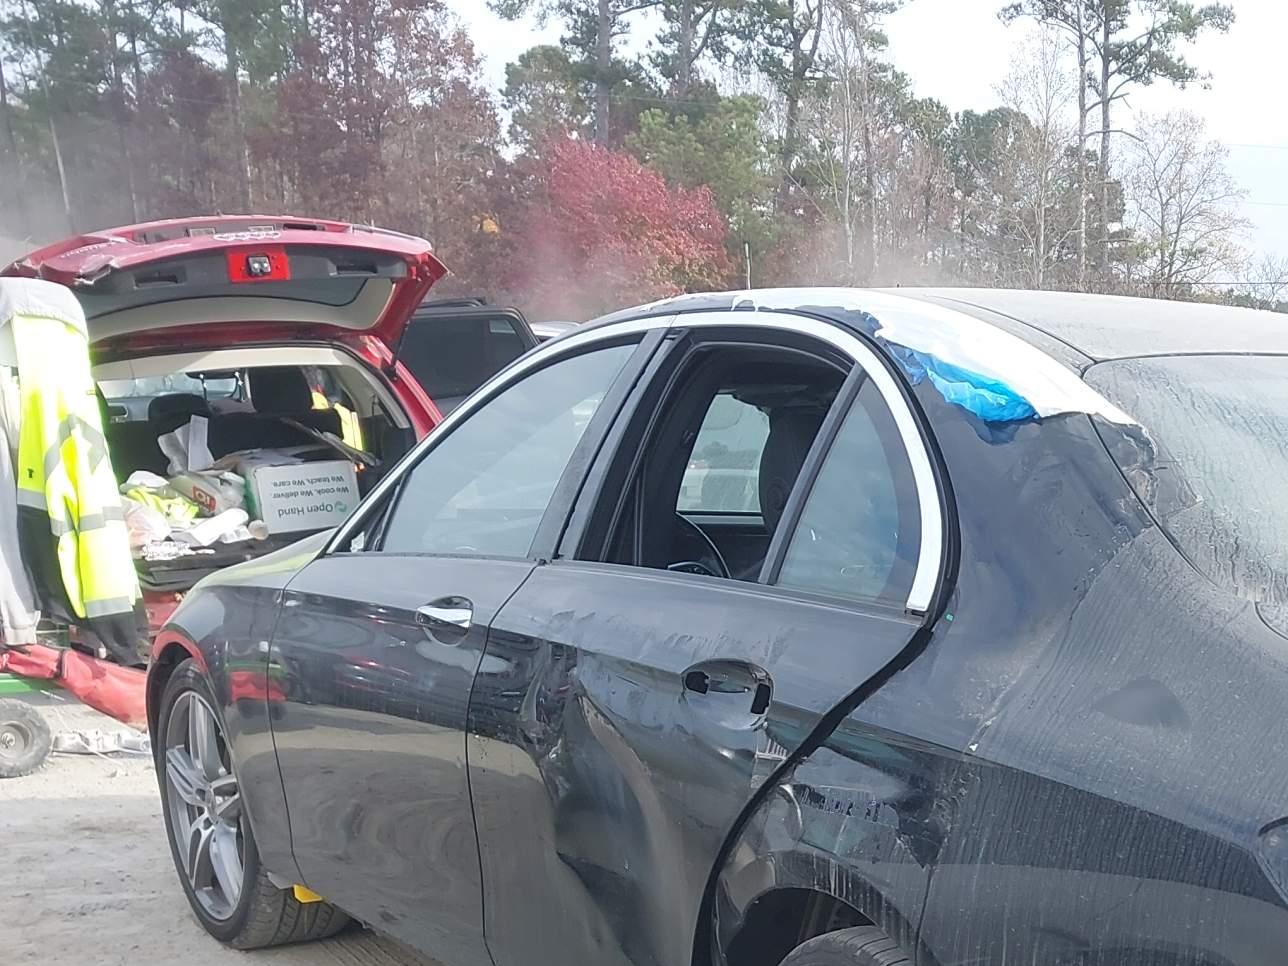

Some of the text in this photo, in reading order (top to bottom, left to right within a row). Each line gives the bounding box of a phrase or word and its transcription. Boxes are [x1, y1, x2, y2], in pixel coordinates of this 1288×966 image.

[300, 489, 314, 497] We
[278, 502, 333, 518] Open Hand
